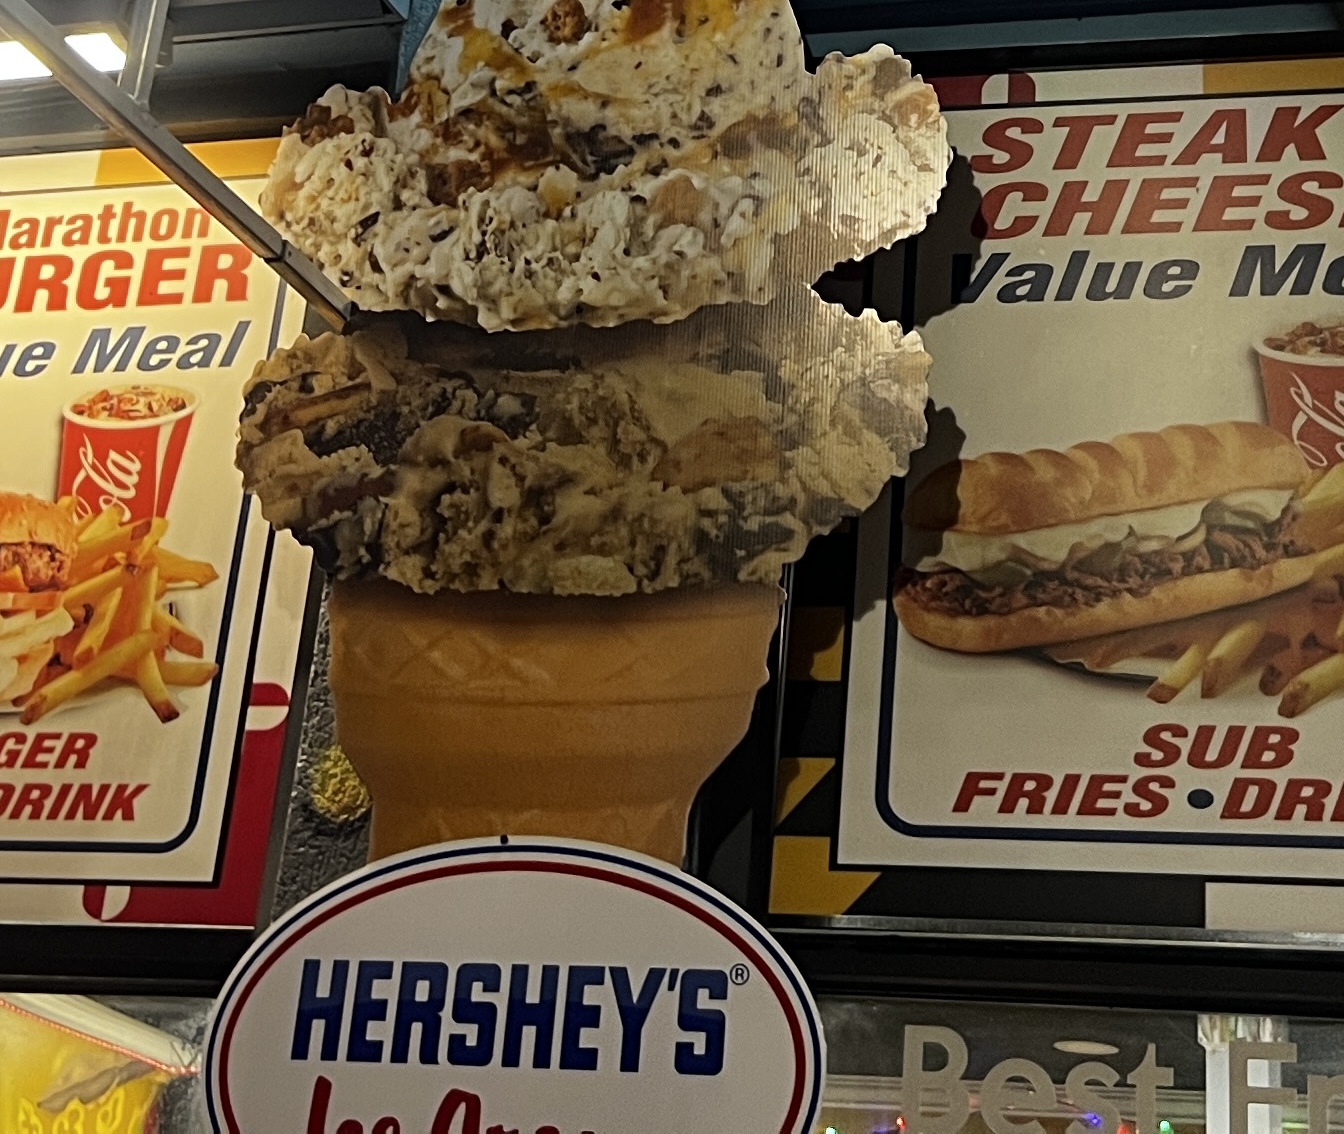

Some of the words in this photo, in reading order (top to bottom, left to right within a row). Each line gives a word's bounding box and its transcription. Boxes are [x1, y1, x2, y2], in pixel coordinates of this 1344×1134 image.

[971, 103, 1344, 172] STEAK
[950, 249, 1201, 305] Value
[71, 320, 251, 375] Meal
[1133, 722, 1300, 770] SUB
[951, 771, 1176, 818] FRIES
[902, 1024, 1174, 1134] Best
